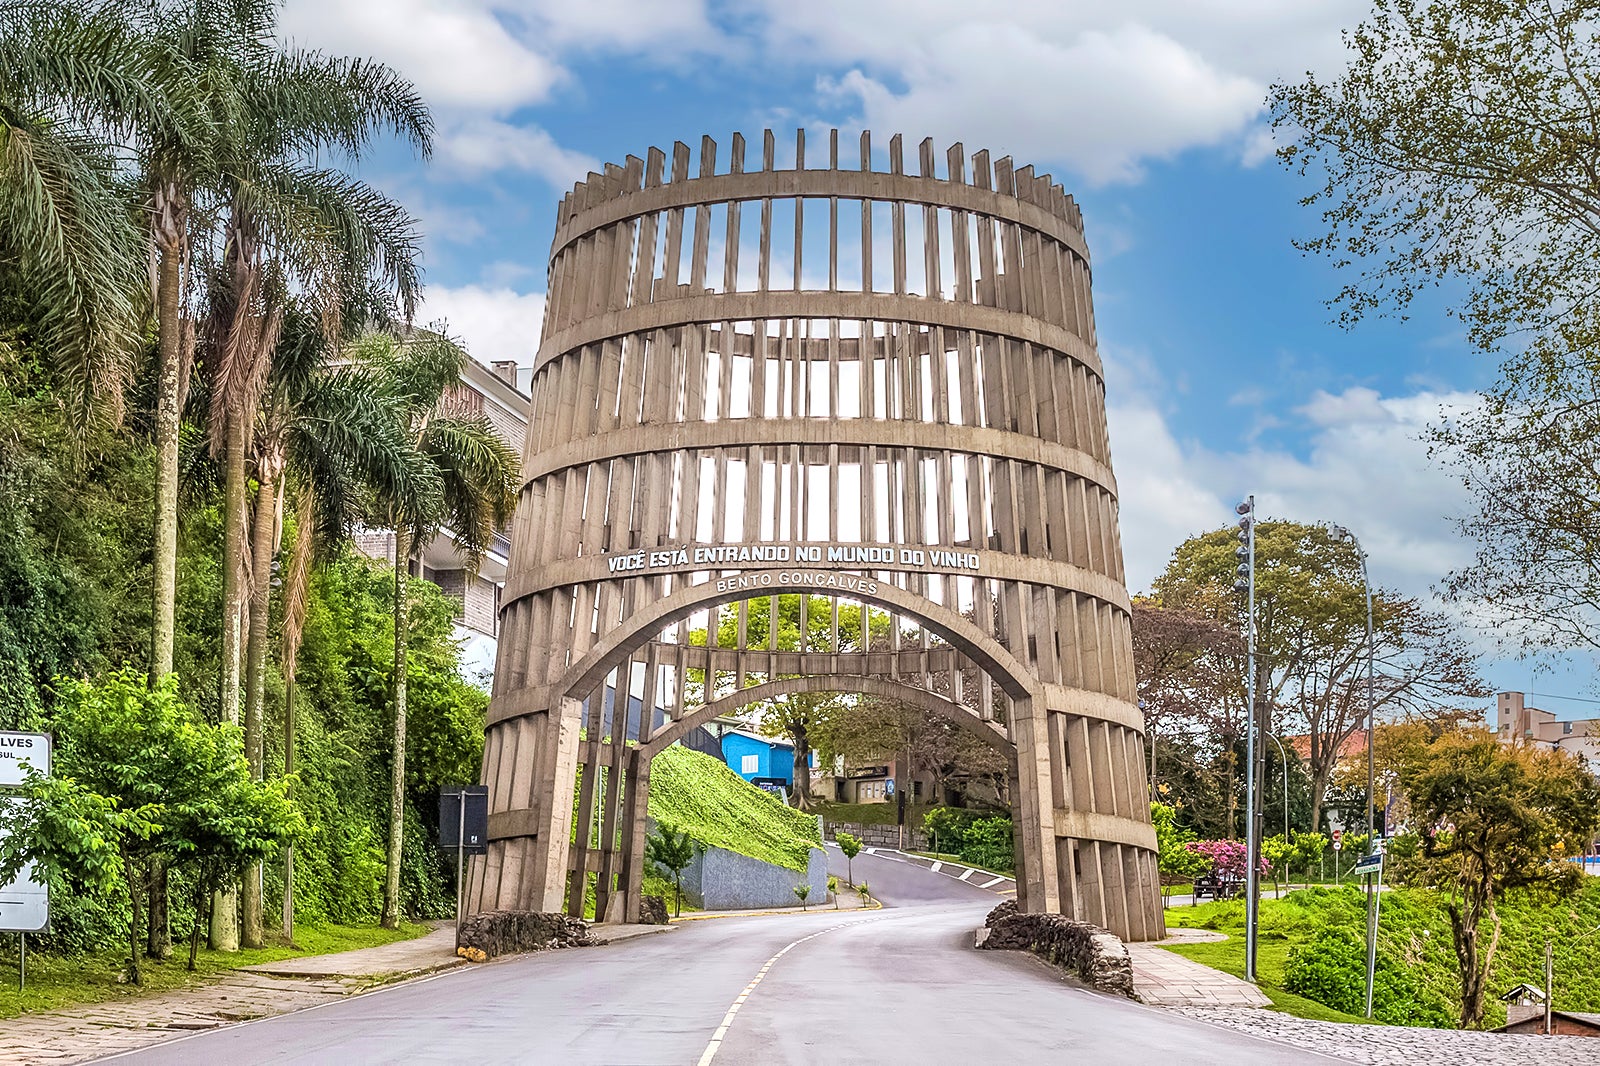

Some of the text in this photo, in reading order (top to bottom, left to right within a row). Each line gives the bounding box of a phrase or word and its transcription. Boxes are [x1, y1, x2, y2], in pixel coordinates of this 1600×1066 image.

[608, 544, 980, 572] VOCÊ ESTÁ ENTRANDO NO MUNDO DO VINHO
[716, 572, 878, 595] BENTO GONÇALVES
